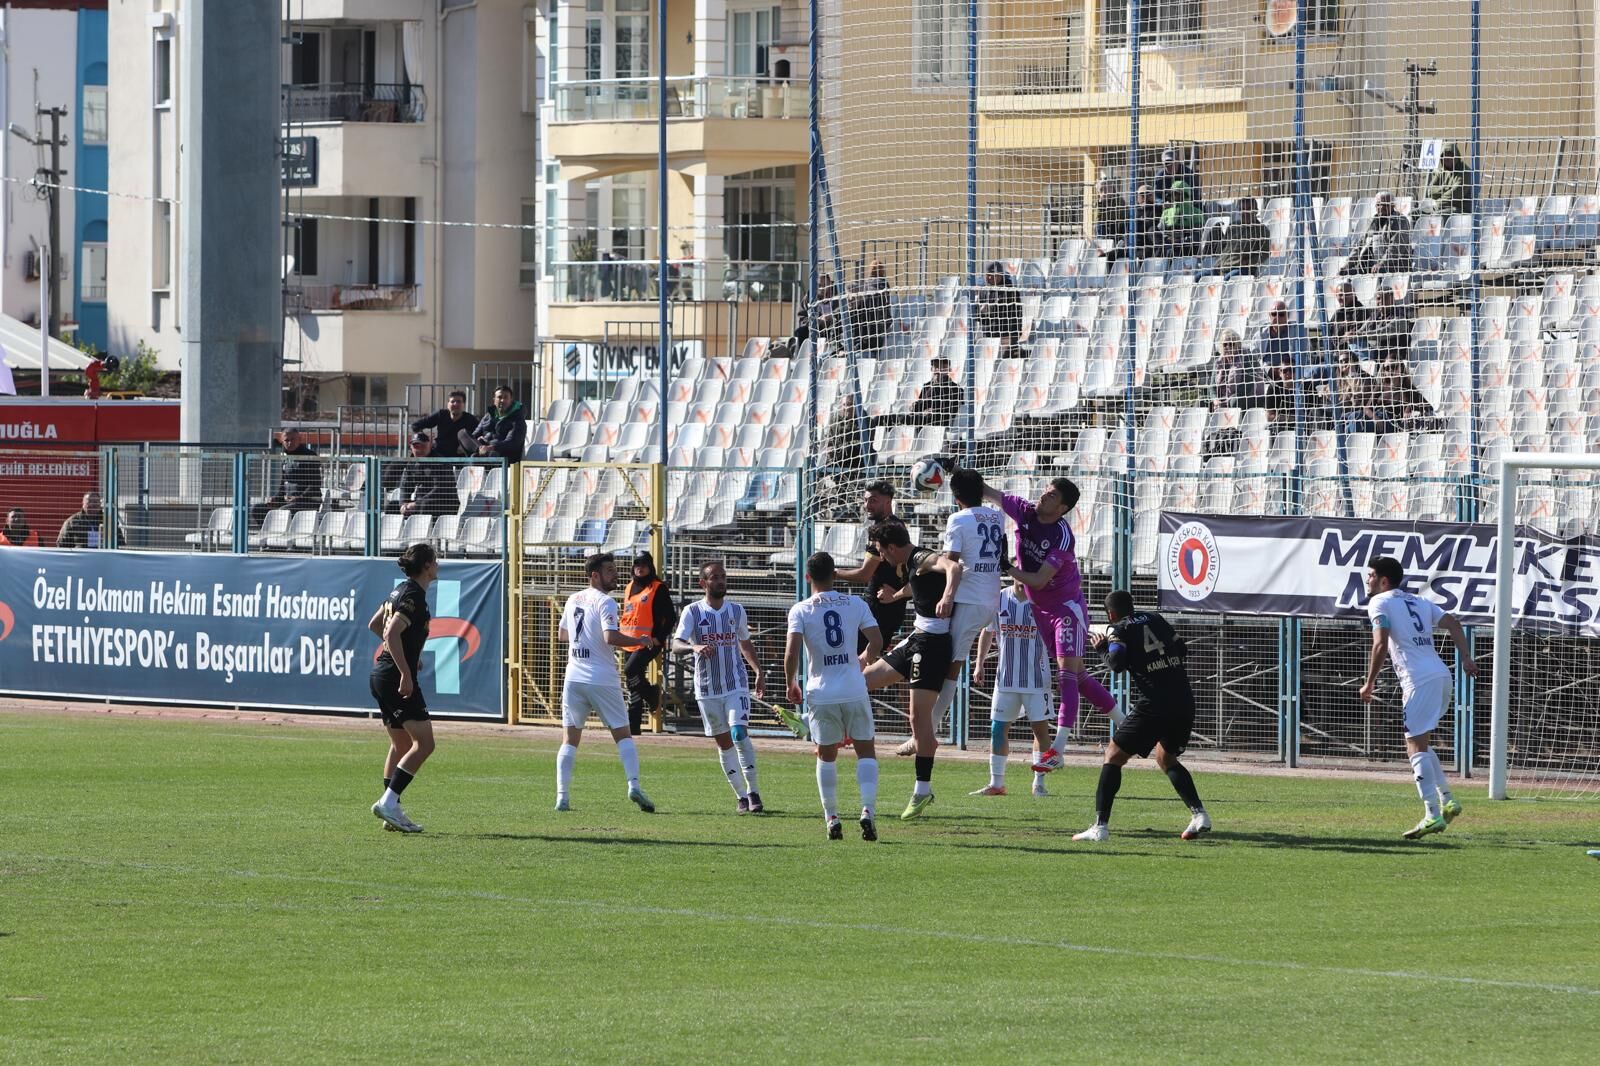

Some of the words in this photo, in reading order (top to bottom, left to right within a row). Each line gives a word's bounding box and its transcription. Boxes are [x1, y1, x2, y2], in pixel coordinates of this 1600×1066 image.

[645, 345, 689, 370] EMAK
[28, 460, 90, 477] BELEDİYESİ
[1318, 531, 1600, 583] MEMLKE
[33, 568, 72, 610] Özel
[77, 576, 144, 614] Lokman
[150, 580, 206, 616] Hekim
[212, 582, 263, 618] Esnaf
[266, 584, 356, 621] Hastanesi
[574, 606, 585, 642] 7
[823, 610, 845, 648] 8
[1000, 623, 1038, 633] ESNAF
[1404, 600, 1425, 633] 5
[701, 632, 736, 642] ESNAF
[1059, 627, 1074, 643] 55
[1143, 624, 1166, 656] 4
[196, 631, 294, 684] Başarılar
[300, 634, 355, 677] Diler
[824, 652, 849, 666] İRFAN
[912, 663, 920, 678] 5
[740, 696, 749, 710] 10
